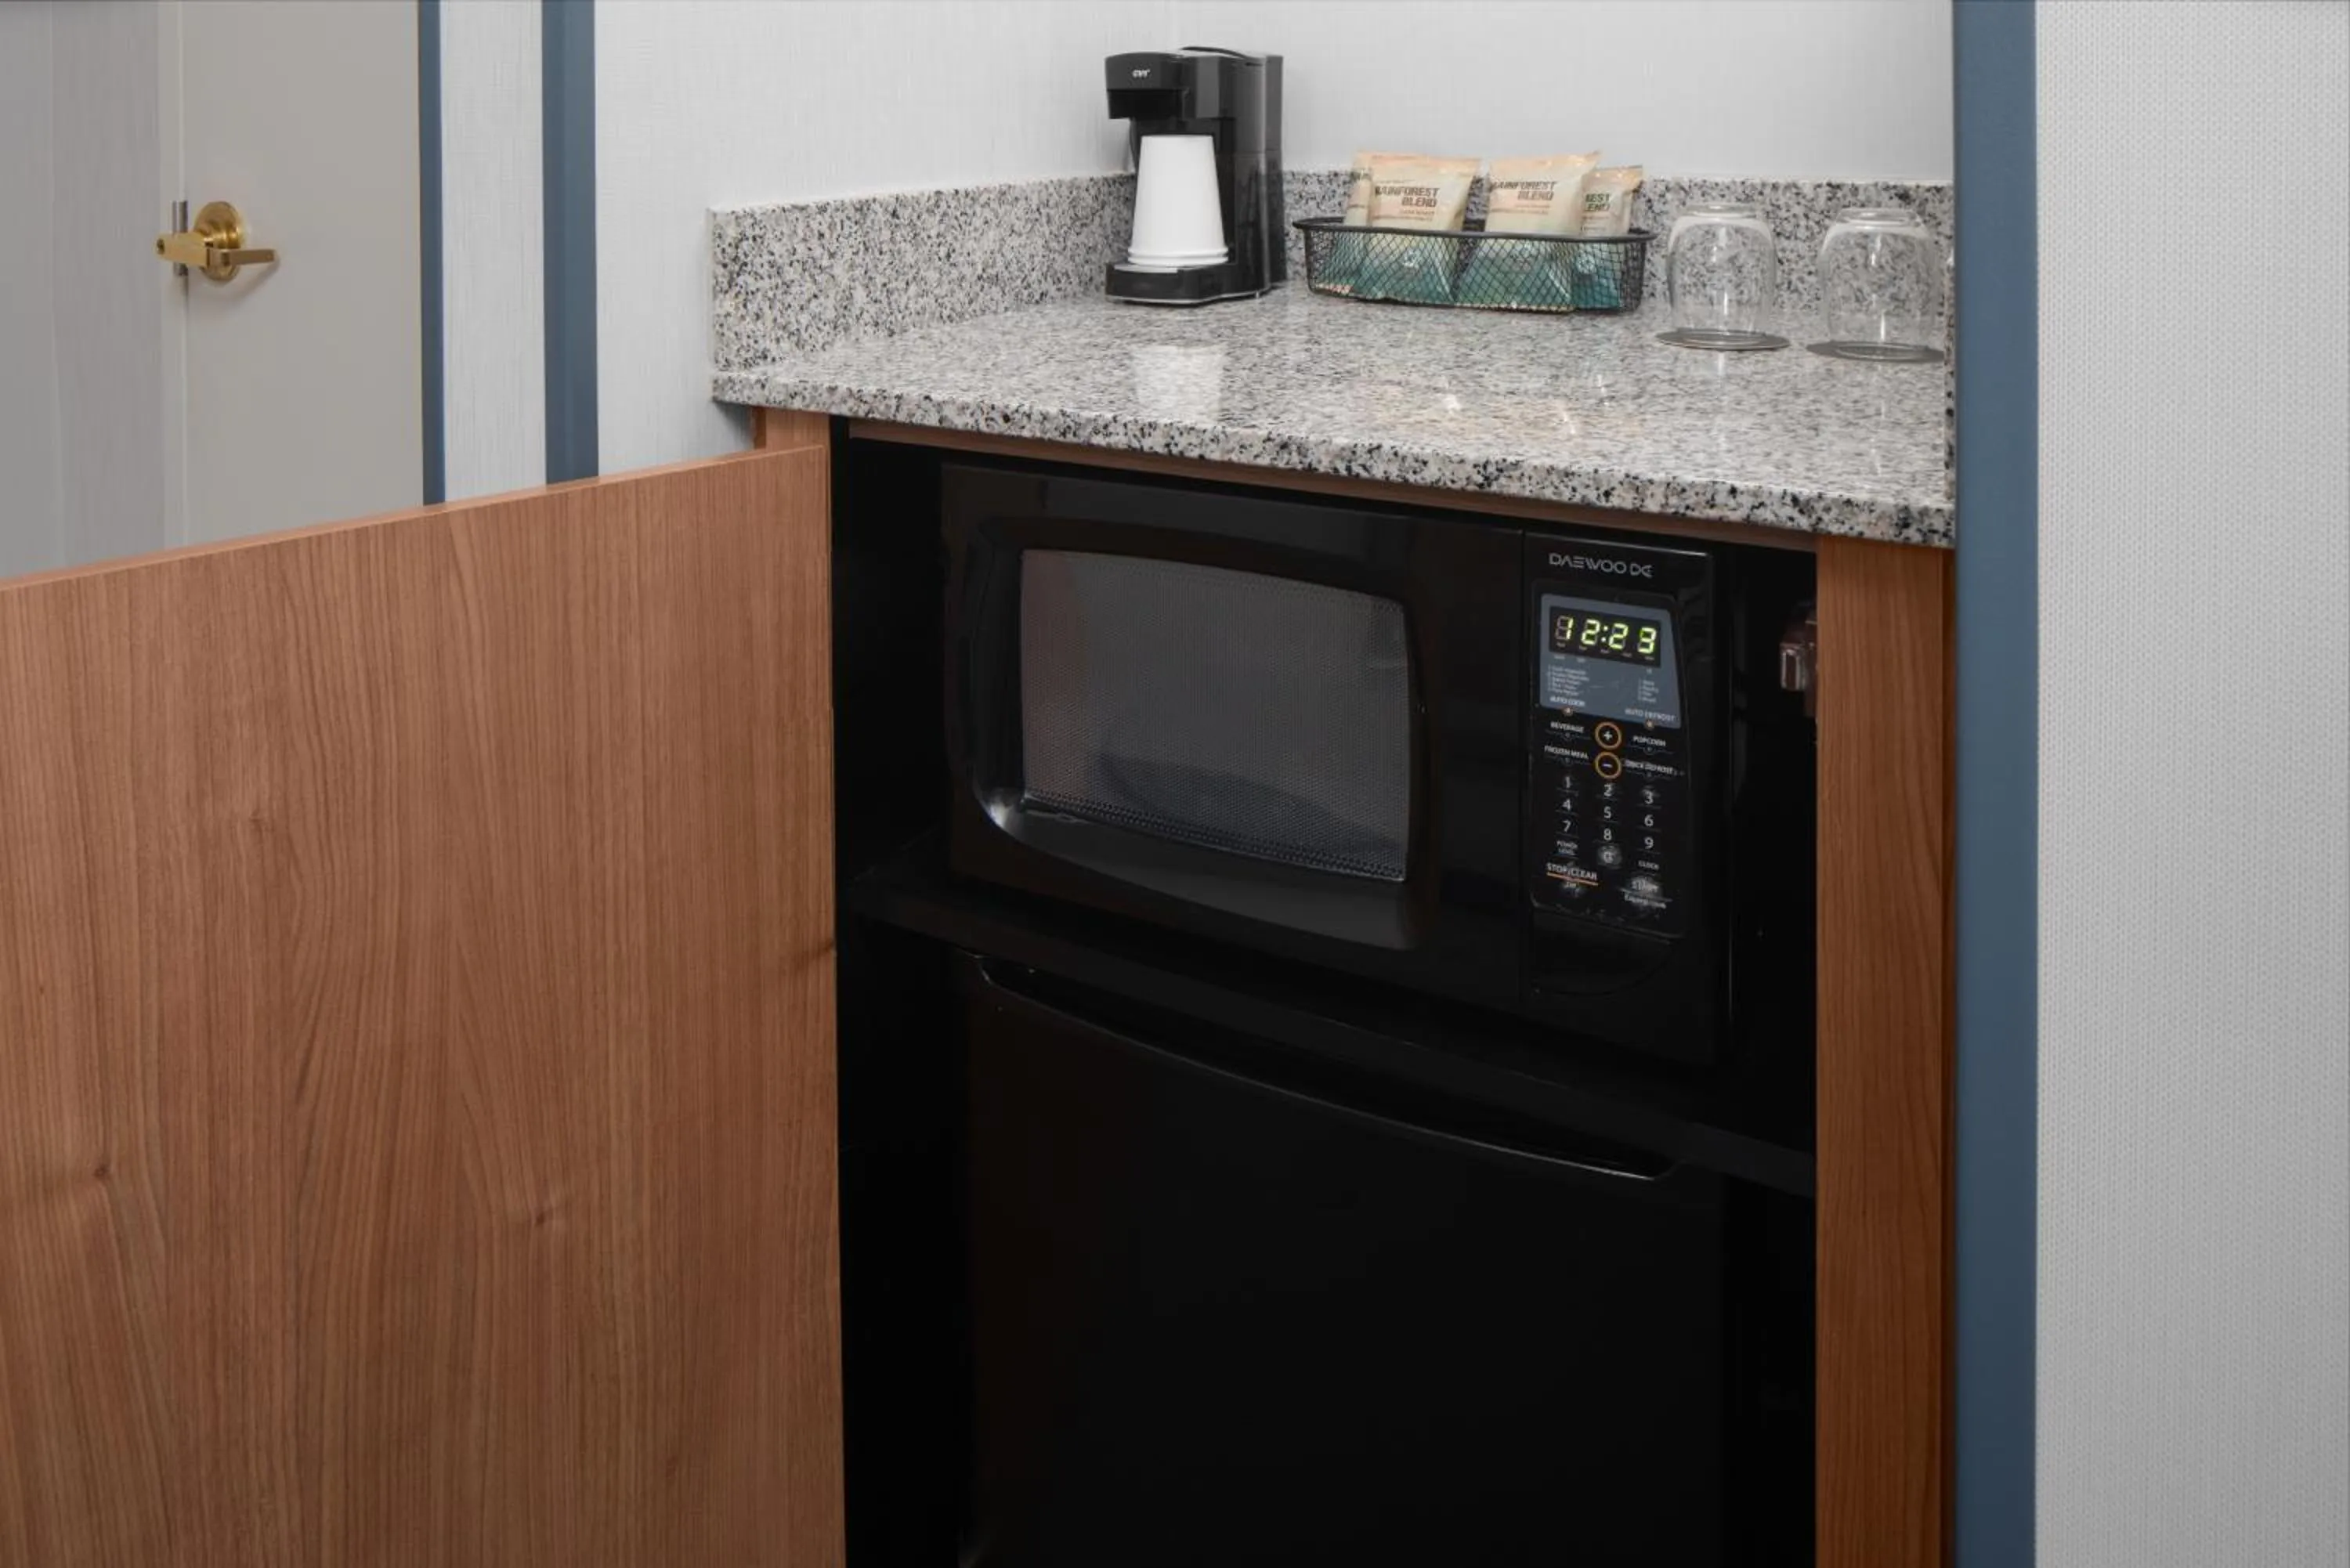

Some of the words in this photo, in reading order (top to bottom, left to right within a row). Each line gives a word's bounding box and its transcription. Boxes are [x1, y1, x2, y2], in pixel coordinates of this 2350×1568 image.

[1402, 197, 1437, 208] BLEND
[1549, 553, 1627, 574] DAEWOO
[1566, 616, 1658, 655] 12:23
[1564, 776, 1571, 789] 1
[1603, 784, 1612, 797] 2
[1644, 790, 1654, 805] 3
[1562, 799, 1571, 811] 4
[1603, 806, 1611, 818] 5
[1562, 820, 1571, 833] 7
[1644, 814, 1654, 827] 6
[1603, 828, 1612, 841] 8
[1644, 836, 1654, 850] 9
